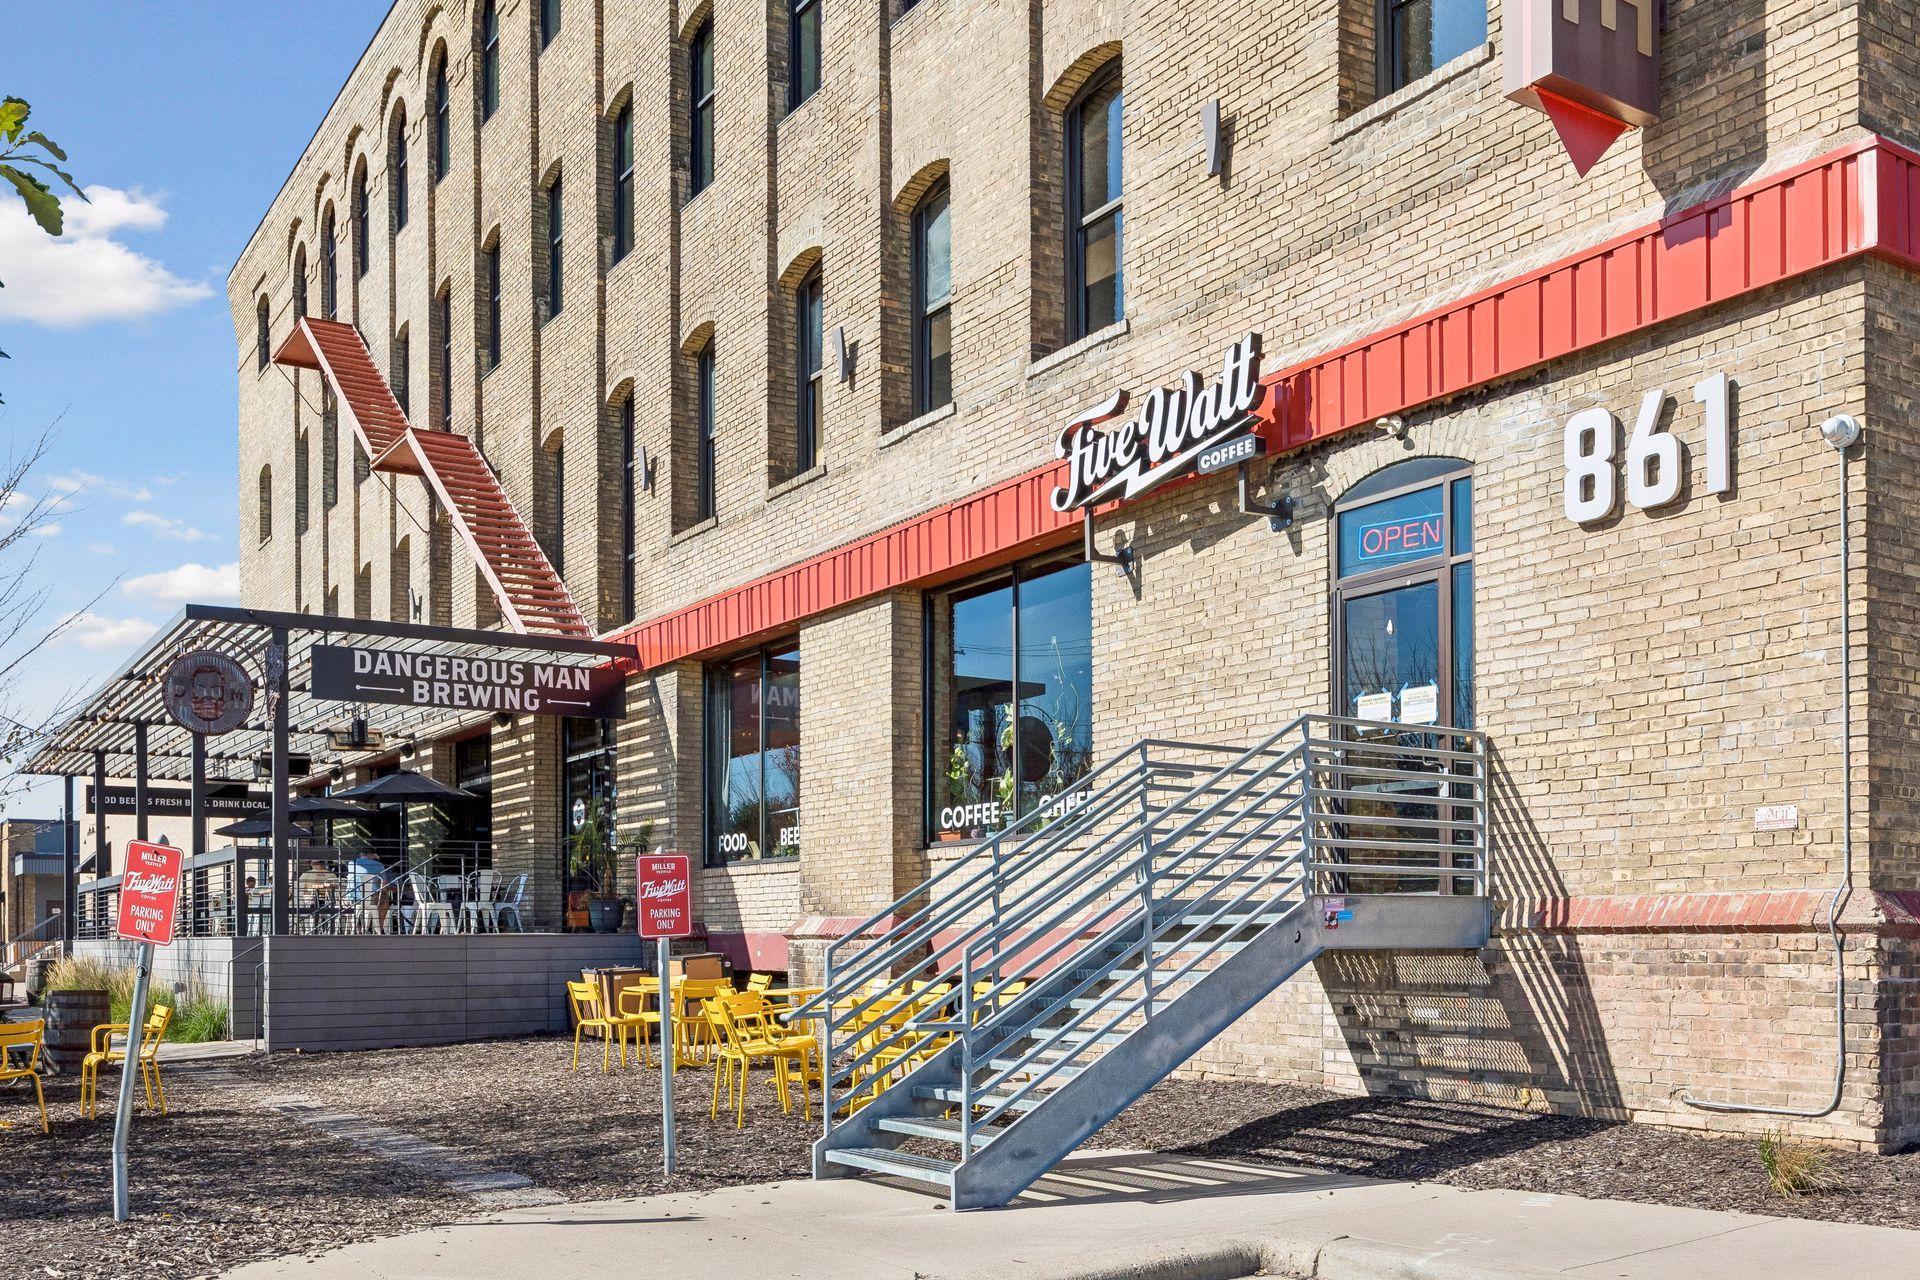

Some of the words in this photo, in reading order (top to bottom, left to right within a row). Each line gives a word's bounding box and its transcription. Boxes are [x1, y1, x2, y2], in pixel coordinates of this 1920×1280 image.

[1051, 388, 1138, 512] Five
[1138, 332, 1266, 462] Watt
[1199, 438, 1254, 469] COFFEE
[1564, 371, 1730, 524] 861
[1363, 519, 1440, 554] OPEN
[353, 650, 524, 685] DANGEROUS
[533, 666, 591, 691] MAN
[412, 680, 541, 712] BREWING
[91, 796, 116, 804] GOD
[119, 796, 136, 805] BEE
[155, 798, 183, 807] FRESH
[212, 800, 240, 808] DRINK
[242, 801, 270, 809] LOCAL.
[941, 801, 1000, 829] COFFEE
[718, 833, 748, 852] FOOD
[780, 826, 800, 846] BEE
[141, 851, 167, 865] MILLER
[651, 862, 676, 871] MILLER
[130, 904, 164, 921] PARKING
[650, 908, 681, 919] PARKING
[135, 918, 156, 933] ONLY
[656, 919, 675, 930] ONLY
